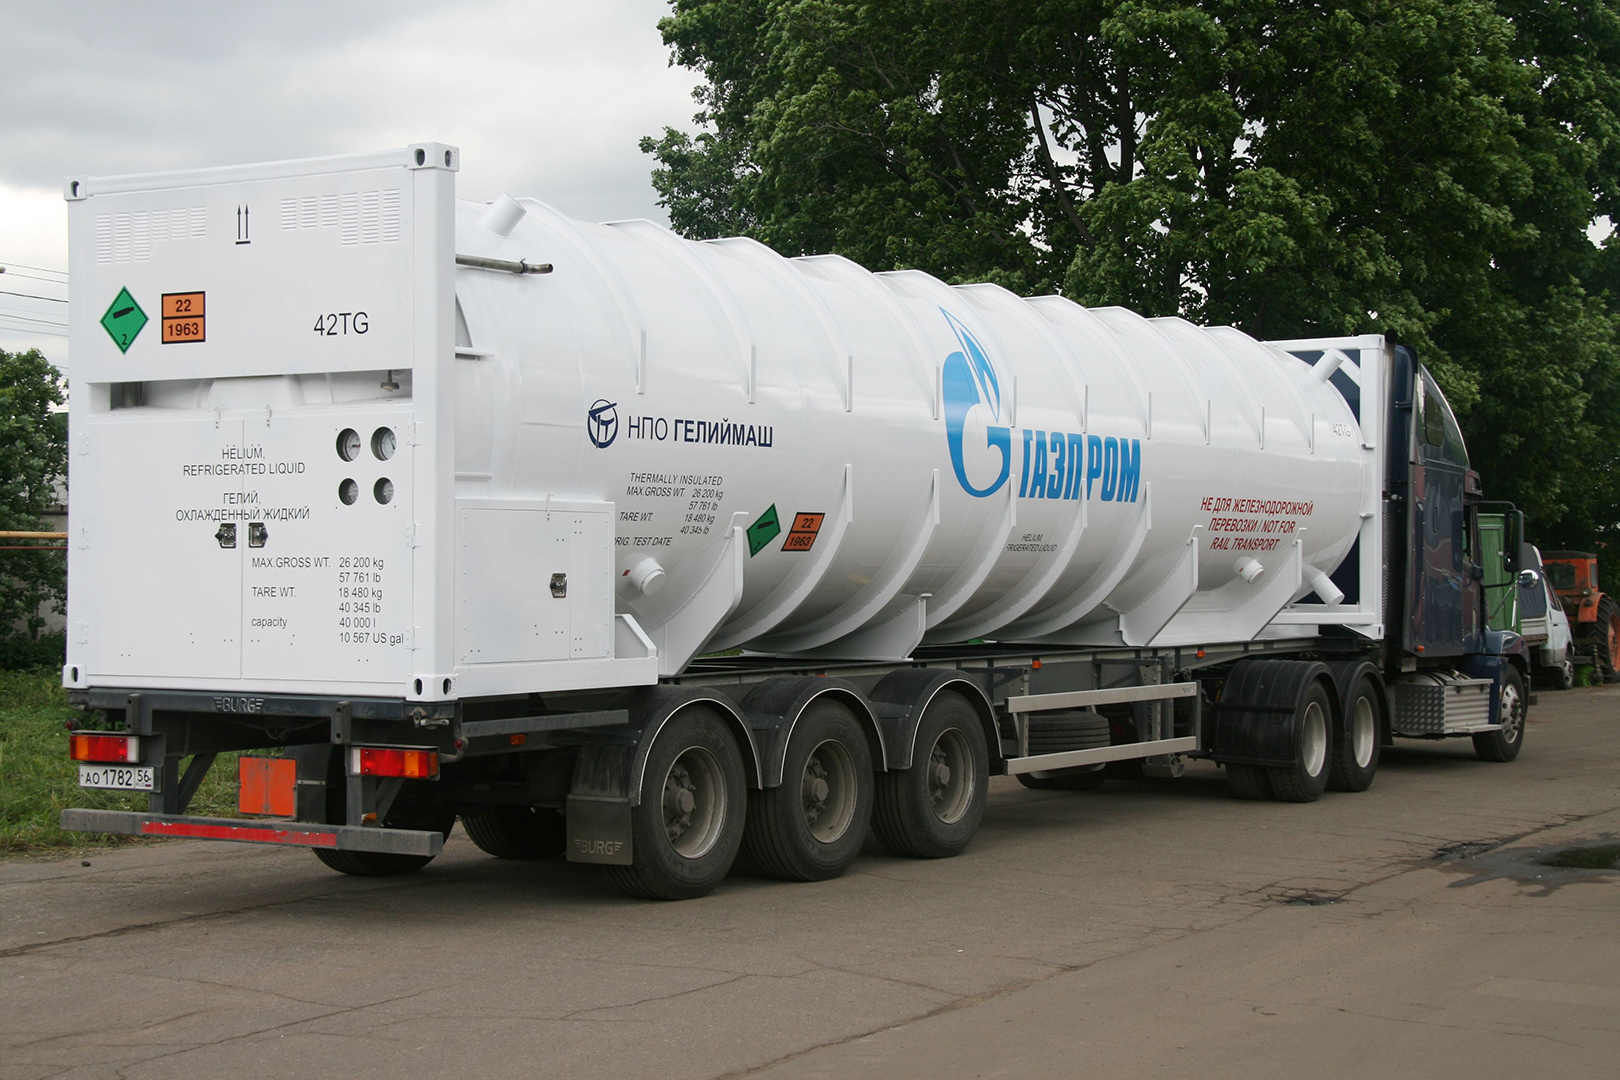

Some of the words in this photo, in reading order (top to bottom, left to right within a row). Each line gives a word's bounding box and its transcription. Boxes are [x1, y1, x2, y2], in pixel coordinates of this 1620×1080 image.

[175, 299, 192, 313] 22
[168, 322, 199, 337] 1963
[313, 311, 370, 337] 42TG
[121, 333, 128, 346] 2
[628, 415, 668, 441] НПО
[674, 417, 773, 447] ГЕЛИЙМАШ
[1332, 423, 1351, 437] 42TG
[222, 447, 265, 460] HELIUM,
[183, 463, 266, 476] REFRIGERATED
[269, 462, 306, 474] LIQUID
[1018, 428, 1141, 503] ГАЗПРОМ
[630, 472, 678, 484] THERMALLY
[680, 475, 723, 486] INSULATED
[223, 490, 261, 505] ГЕЛИЙ,
[673, 488, 685, 497] WT.
[692, 489, 701, 498] 26
[701, 489, 715, 498] 200
[715, 489, 724, 501] kg
[688, 501, 698, 511] 57
[698, 501, 711, 511] 761
[711, 502, 718, 511] lb
[1200, 497, 1213, 511] НЕ
[1212, 498, 1232, 514] ДЛЯ
[1232, 498, 1314, 516] ЖЕЛЕЗНОДОРОЖНОЙ
[176, 507, 260, 522] ОХЛАЖДЕННЫЙ
[263, 506, 310, 521] ЖИДКИЙ
[619, 512, 639, 521] TARE
[640, 512, 653, 522] WT.
[684, 513, 693, 522] 18
[693, 513, 706, 523] 480
[705, 514, 715, 525] kg
[801, 518, 814, 528] 22
[1208, 518, 1258, 532] ПЕРЕВОЗКИ
[1261, 520, 1280, 533] NOT
[1278, 521, 1296, 533] FOR
[680, 526, 690, 534] 40
[689, 526, 702, 535] 345
[702, 526, 710, 535] lb
[632, 537, 652, 546] TEST
[652, 537, 673, 546] DATE
[753, 542, 761, 551] 2
[789, 536, 811, 546] 1963
[1006, 543, 1039, 551] RIGERATED
[1210, 537, 1230, 550] RAIL
[1231, 538, 1280, 551] TRANSPORT
[314, 557, 331, 568] WT.
[339, 557, 350, 568] 26
[353, 557, 370, 568] 200
[373, 557, 384, 570] kg
[339, 572, 350, 583] 57
[353, 572, 370, 583] 761
[373, 572, 381, 583] lb
[252, 587, 277, 597] TARE
[279, 587, 297, 597] WT.
[339, 587, 349, 598] 18
[352, 587, 369, 598] 480
[371, 587, 383, 600] kg
[339, 602, 350, 613] 40
[353, 602, 370, 613] 345
[373, 602, 381, 613] lb
[251, 617, 288, 629] capacity
[339, 617, 350, 628] 40
[353, 617, 371, 628] 000
[339, 632, 350, 643] 10
[353, 632, 370, 643] 567
[373, 633, 387, 644] US
[389, 633, 404, 646] gal
[222, 697, 256, 713] BURG
[102, 769, 133, 786] 1782
[137, 769, 150, 782] 56
[580, 839, 614, 856] BURG
